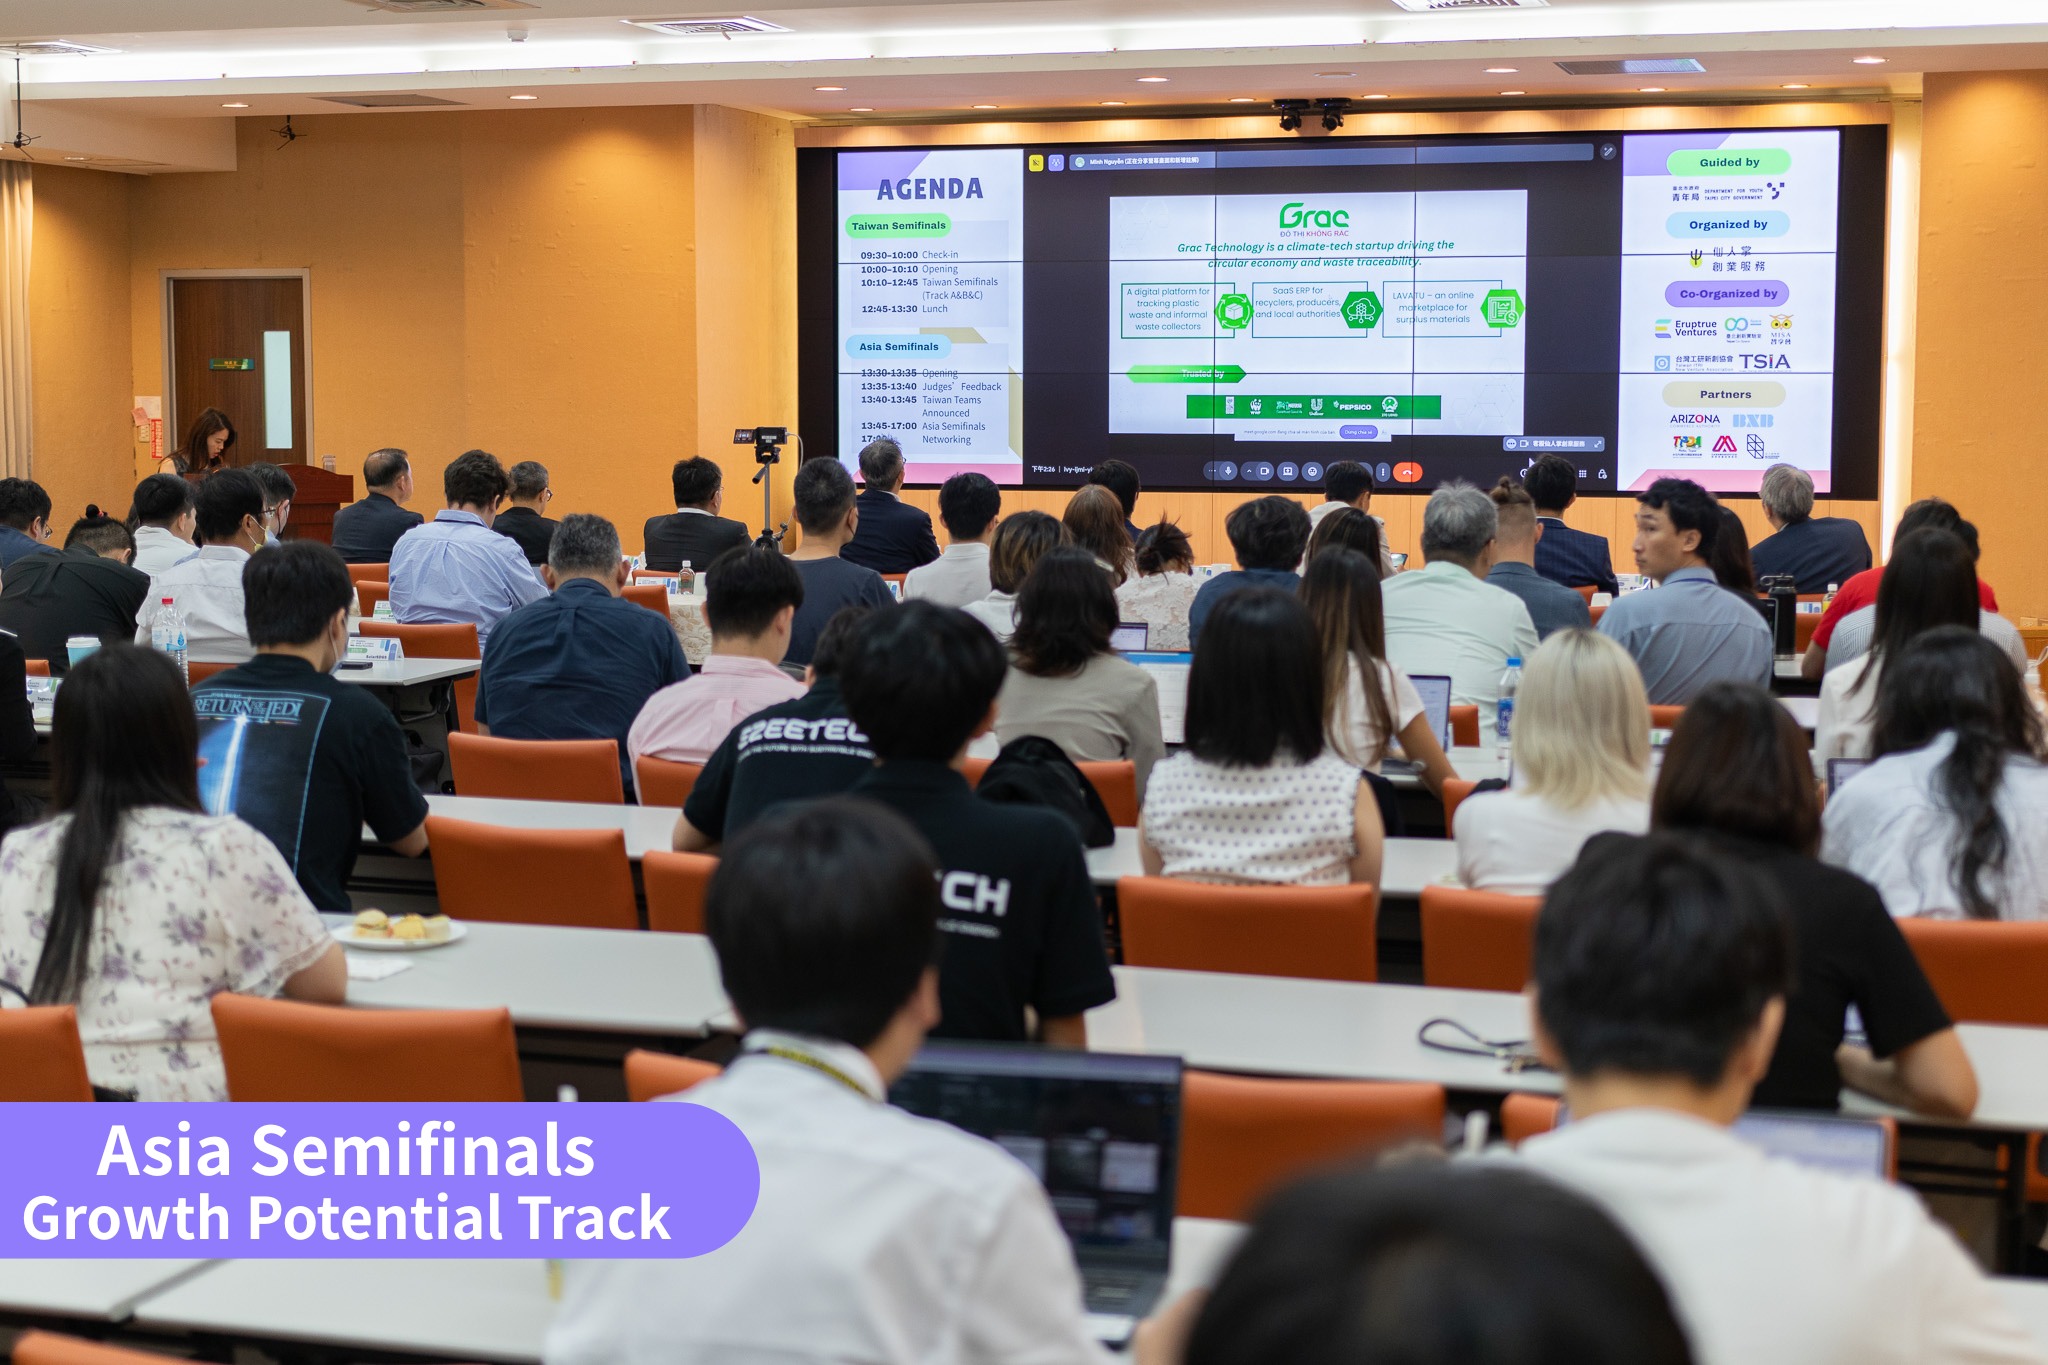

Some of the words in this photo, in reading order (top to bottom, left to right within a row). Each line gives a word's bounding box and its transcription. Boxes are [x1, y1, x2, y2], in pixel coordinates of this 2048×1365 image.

[1700, 158, 1742, 167] Guided
[1746, 158, 1760, 168] by
[877, 178, 983, 200] AGENDA
[1280, 203, 1349, 228] Grac
[852, 222, 889, 231] Taiwan
[892, 221, 946, 230] Semifinals
[1689, 220, 1750, 231] Organized
[1754, 220, 1768, 231] by
[1177, 243, 1202, 253] Grac
[1204, 242, 1264, 255] Technology
[1266, 242, 1275, 252] is
[1286, 241, 1353, 252] climate-tech
[1355, 241, 1394, 253] startup
[1396, 240, 1435, 252] driving
[1437, 240, 1454, 250] the
[922, 251, 959, 259] Check-in
[1208, 258, 1248, 268] circular
[1250, 260, 1298, 269] economy
[1300, 257, 1321, 267] and
[1323, 258, 1354, 268] waste
[1356, 256, 1422, 269] traceability.
[1712, 261, 1765, 272] 創業服務
[922, 265, 959, 275] Opening
[922, 278, 952, 286] Taiwan
[954, 277, 998, 286] Semifinals
[922, 291, 949, 300] (Track
[951, 291, 983, 300] A&B&C)
[1134, 287, 1160, 297] digital
[1162, 287, 1196, 297] platform
[1199, 287, 1210, 295] for
[1272, 286, 1294, 295] SaaS
[1312, 286, 1323, 294] for
[1448, 291, 1475, 299] online
[1680, 289, 1760, 300] Co-Organized
[1764, 289, 1778, 300] by
[1137, 299, 1170, 309] tracking
[1172, 299, 1200, 308] plastic
[1255, 299, 1294, 308] recyclers,
[1399, 303, 1454, 313] marketplace
[1456, 303, 1468, 311] for
[862, 305, 918, 313] 12:45-13:30
[922, 305, 948, 313] Lunch
[1255, 310, 1272, 318] and
[1274, 310, 1294, 318] local
[1296, 310, 1341, 318] authorities
[1155, 311, 1171, 319] and
[1173, 311, 1208, 319] informal
[1396, 315, 1428, 325] surplus
[1429, 315, 1471, 323] materials
[1135, 323, 1160, 331] waste
[1161, 322, 1201, 330] collectors
[1675, 320, 1717, 329] Eruptrue
[859, 343, 882, 351] Asia
[885, 342, 939, 351] Semifinals
[922, 368, 959, 379] Opening
[1182, 369, 1211, 378] Trusted
[1215, 369, 1224, 380] by
[861, 383, 917, 391] 13:35-13:40
[961, 382, 1002, 391] Feedback
[1700, 390, 1752, 399] Partners
[861, 396, 917, 404] 13:40-13:45
[922, 396, 952, 404] Taiwan
[954, 396, 981, 404] Teams
[922, 409, 970, 417] Announced
[1670, 414, 1720, 424] ARIZONA
[1733, 414, 1774, 428] BXB
[861, 422, 917, 430] 13:45-17:00
[922, 422, 939, 431] Asia
[941, 421, 986, 431] Semifinals
[922, 435, 972, 445] Networking
[195, 699, 252, 714] RETURN
[264, 701, 302, 723] JEDI
[933, 869, 1011, 917] CH
